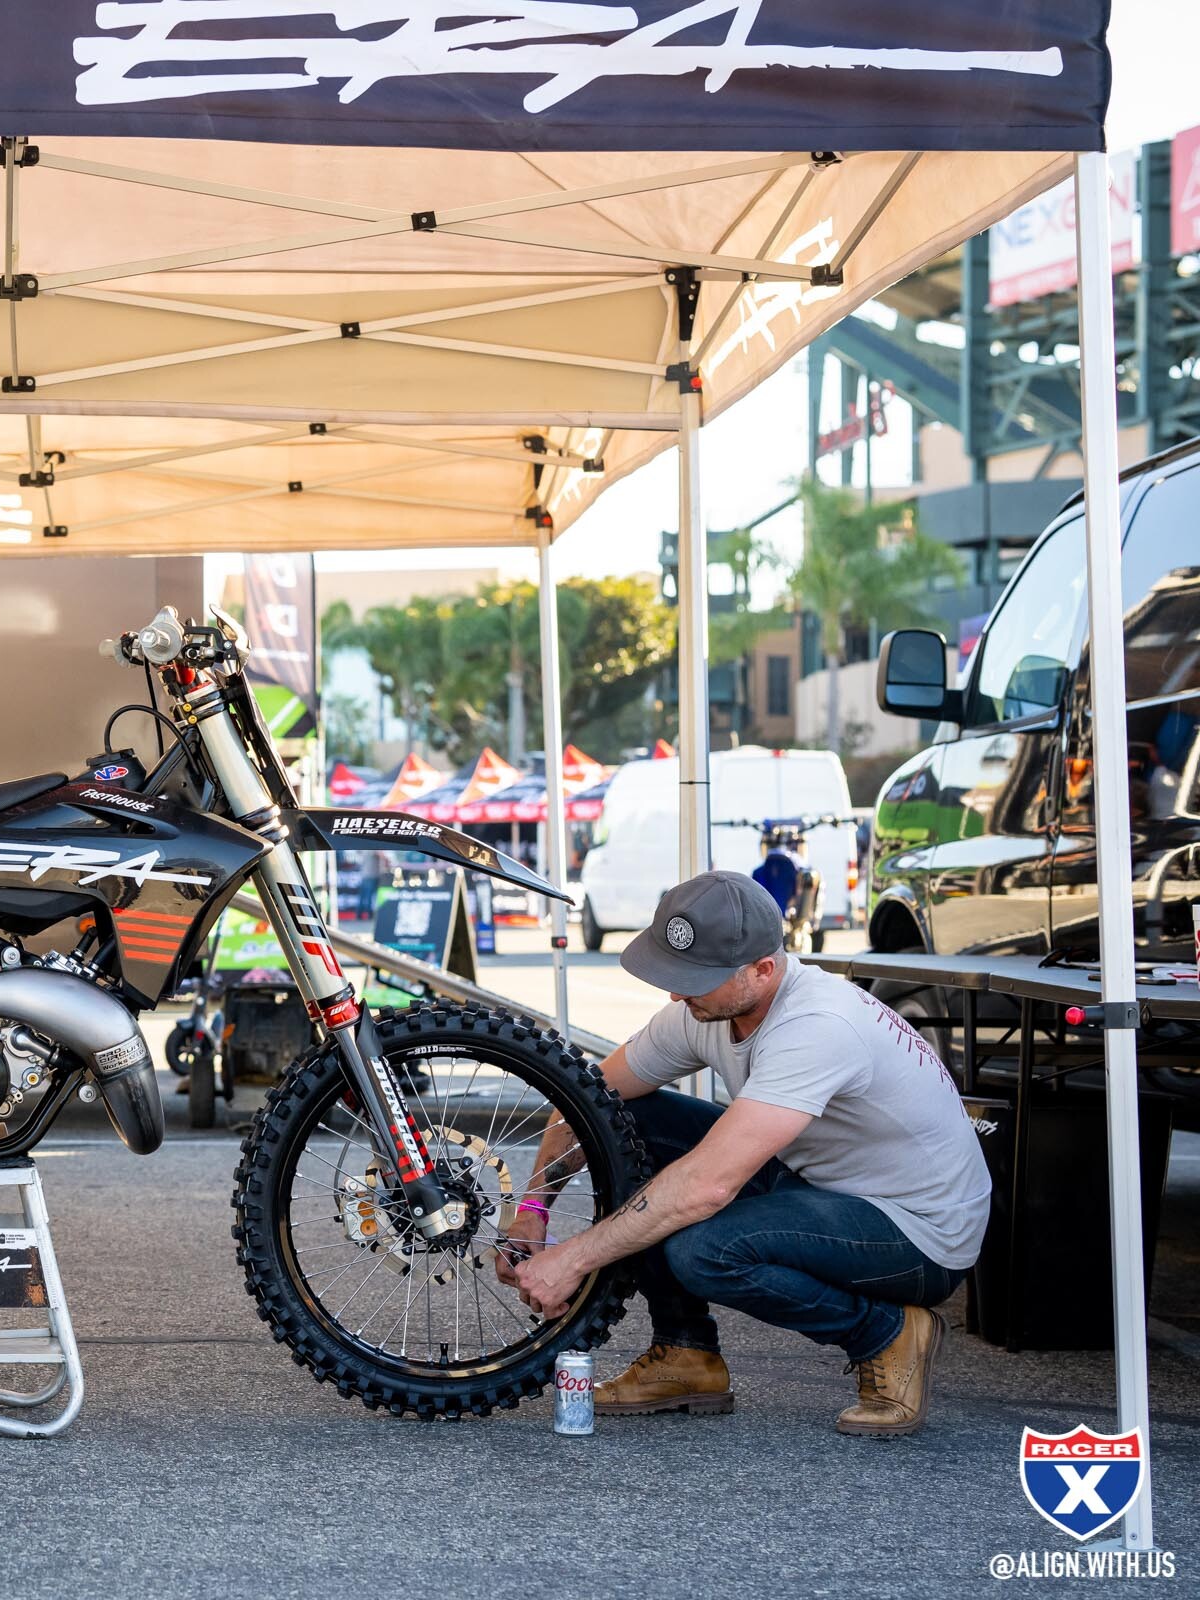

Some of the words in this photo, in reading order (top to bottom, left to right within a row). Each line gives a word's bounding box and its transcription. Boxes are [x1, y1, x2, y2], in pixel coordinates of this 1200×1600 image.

[73, 0, 1061, 114] ERA
[79, 788, 155, 813] FASTHOUSE
[333, 817, 442, 835] HAESEKER
[382, 829, 440, 838] engines
[370, 1056, 426, 1170] DUNLOP
